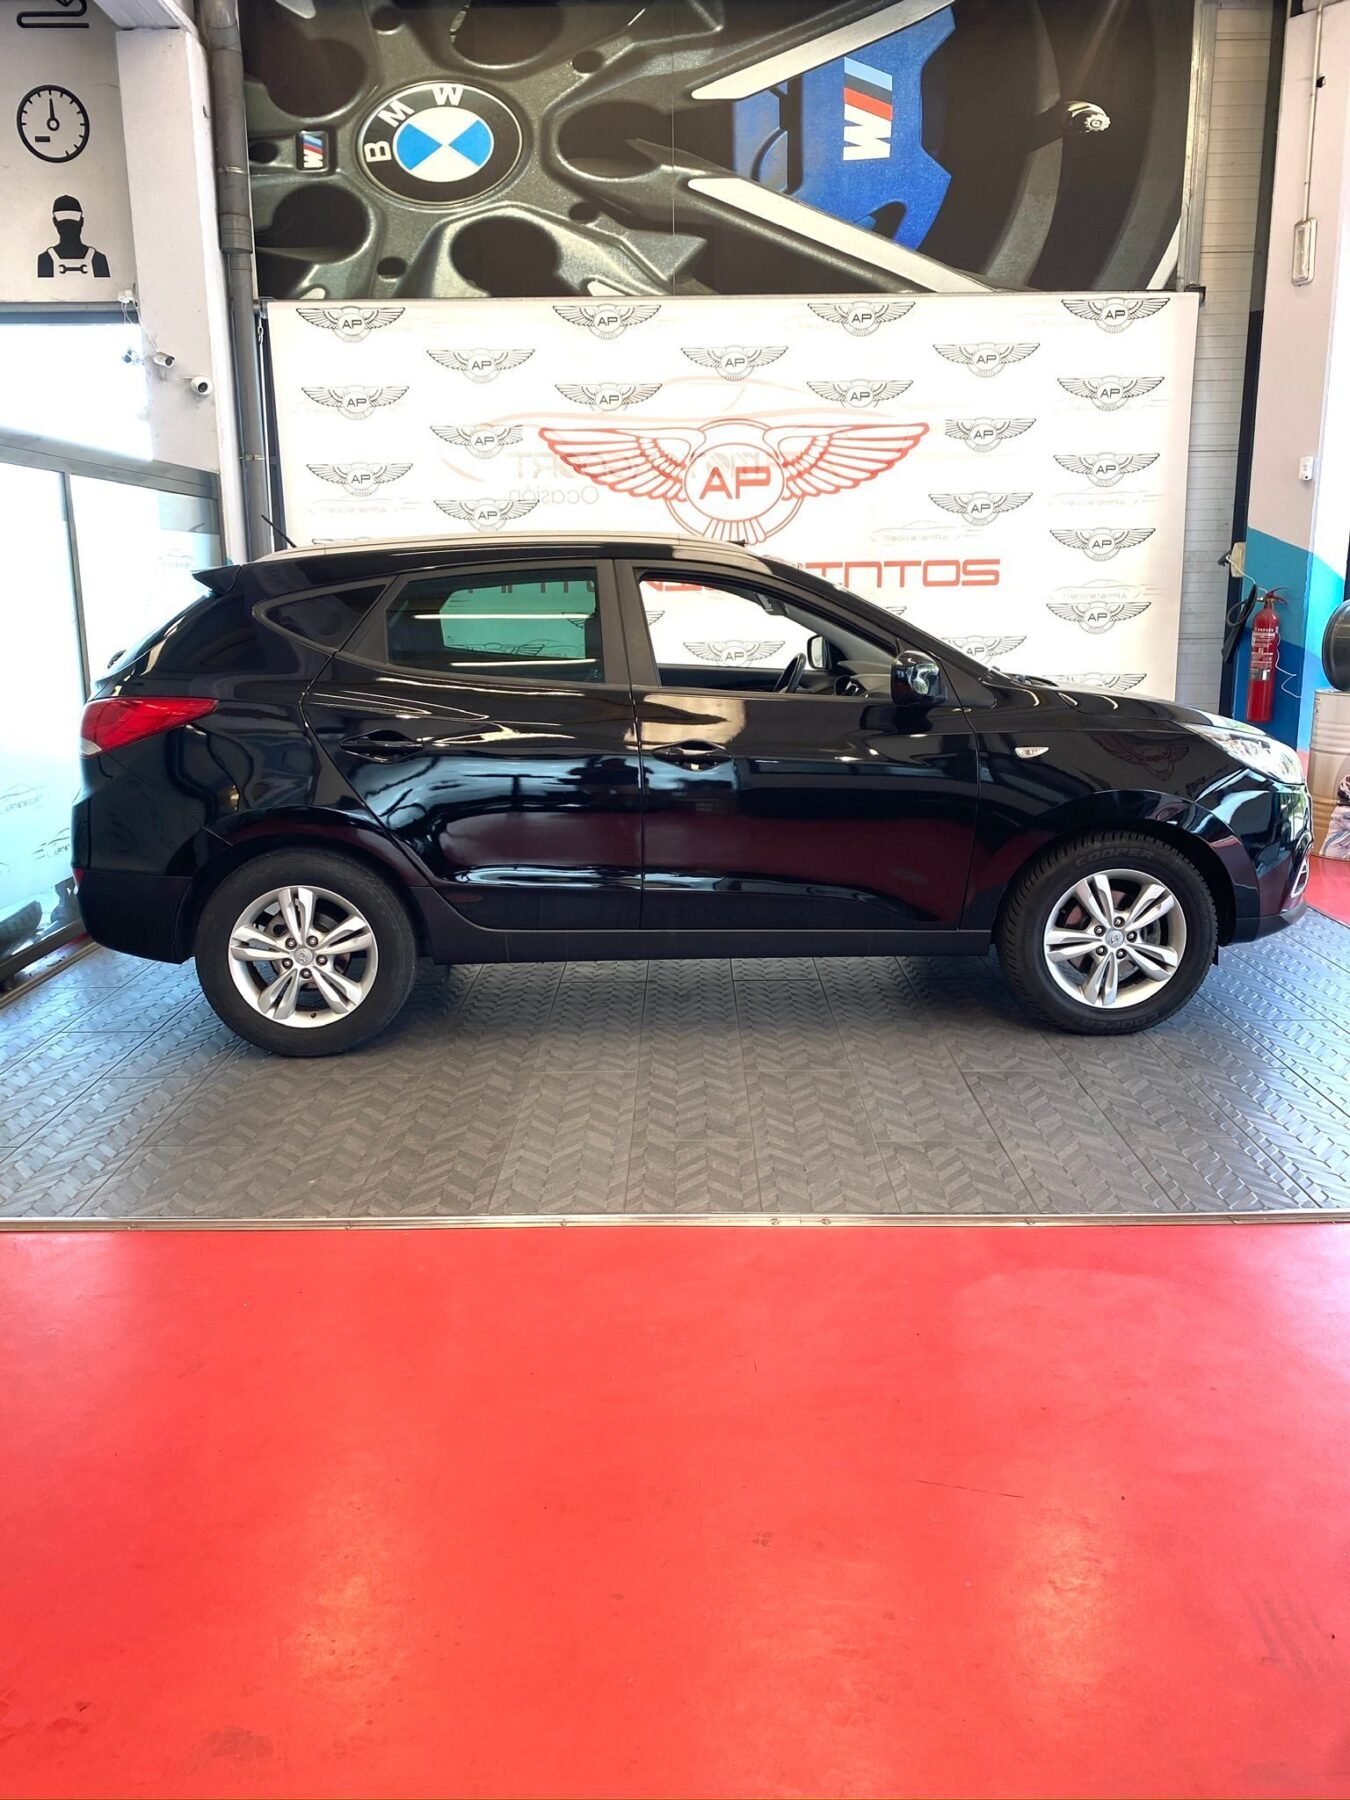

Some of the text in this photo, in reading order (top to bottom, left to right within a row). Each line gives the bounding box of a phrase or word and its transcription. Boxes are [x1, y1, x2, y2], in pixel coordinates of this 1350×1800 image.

[363, 86, 464, 163] BMW
[852, 313, 872, 323] AP
[1105, 309, 1126, 319] AP
[342, 319, 363, 329] AP
[597, 316, 618, 326] AP
[725, 358, 745, 367] AP
[976, 355, 997, 364] AP
[472, 361, 493, 370] AP
[850, 391, 870, 401] AP
[1100, 388, 1120, 398] AP
[347, 398, 367, 407] AP
[599, 395, 620, 405] AP
[973, 430, 994, 439] AP
[475, 436, 495, 446] AP
[1096, 464, 1117, 474] AP
[351, 474, 371, 484] AP
[700, 465, 771, 500] AP
[971, 503, 991, 513] AP
[478, 510, 498, 520] AP
[1092, 539, 1112, 549] AP
[1088, 612, 1108, 621] AP
[725, 651, 745, 660] AP
[966, 646, 985, 655] AP
[1075, 847, 1154, 867] COOPER
